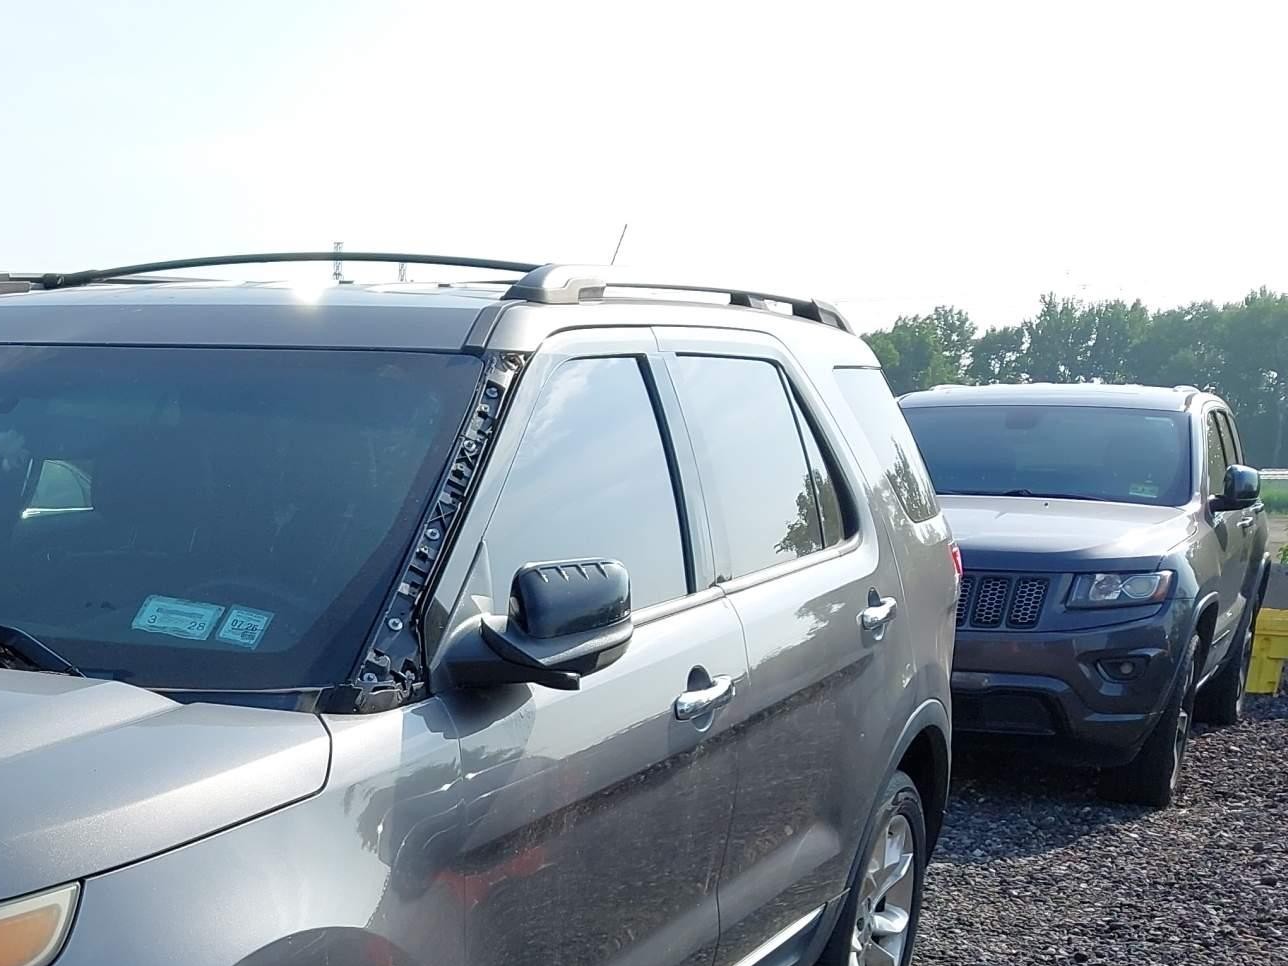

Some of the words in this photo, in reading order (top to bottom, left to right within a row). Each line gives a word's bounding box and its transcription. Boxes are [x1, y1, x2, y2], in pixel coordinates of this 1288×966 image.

[148, 614, 158, 624] 3
[187, 621, 206, 631] 28
[231, 619, 244, 629] 07
